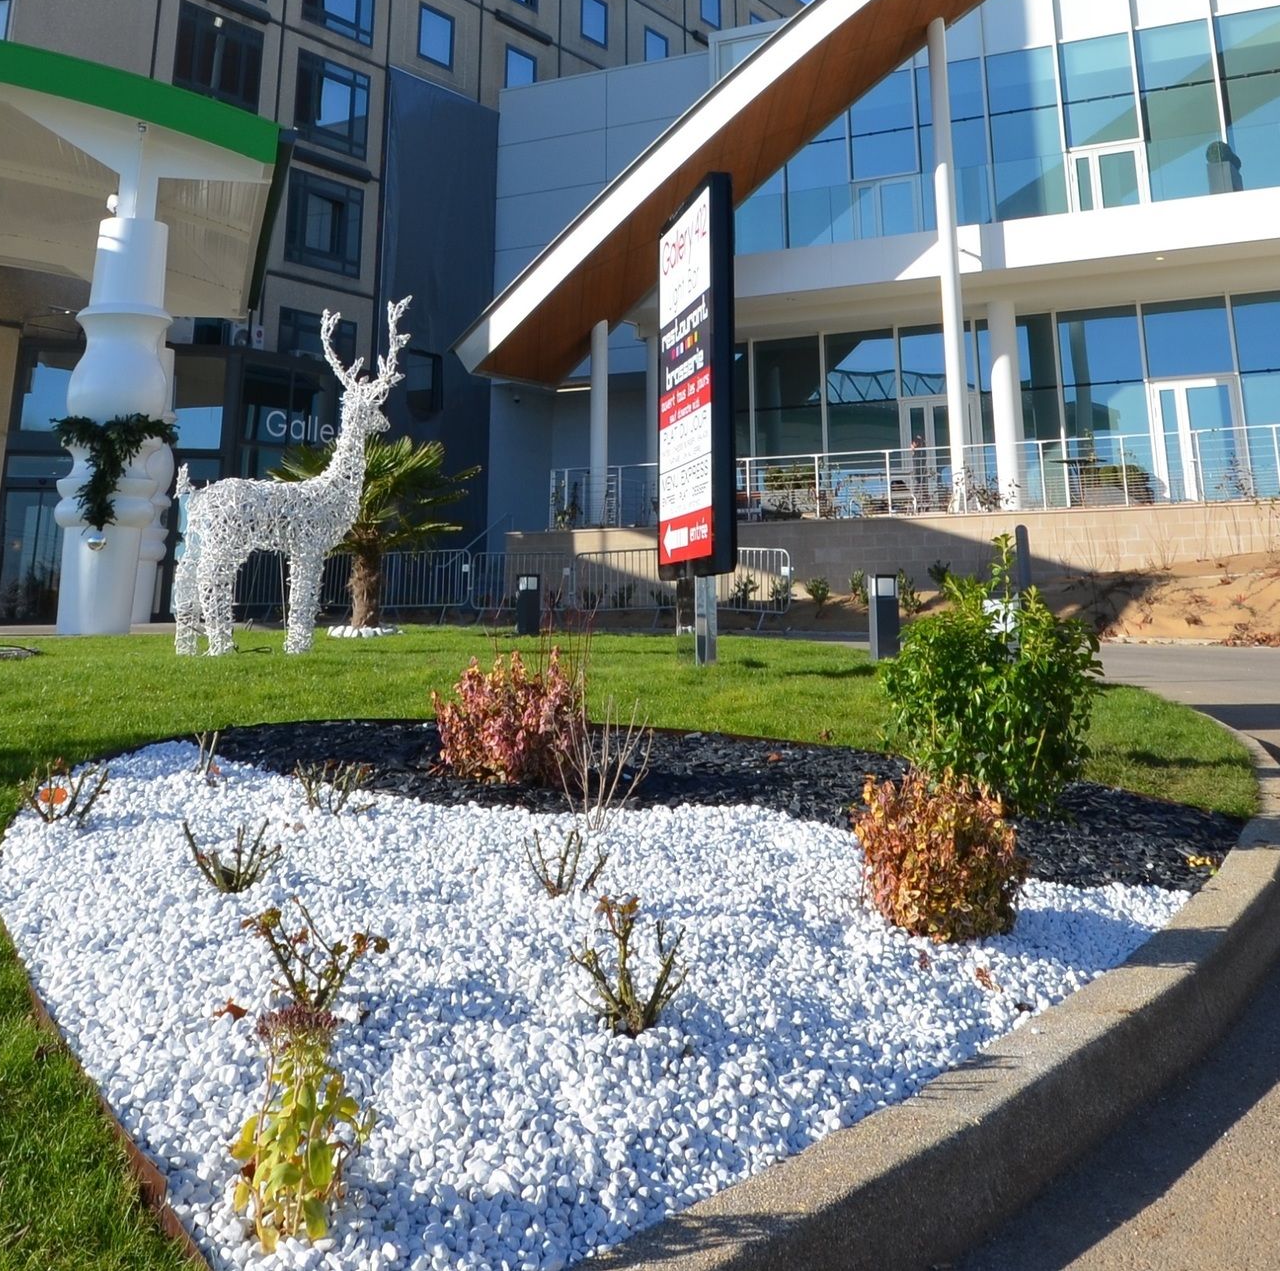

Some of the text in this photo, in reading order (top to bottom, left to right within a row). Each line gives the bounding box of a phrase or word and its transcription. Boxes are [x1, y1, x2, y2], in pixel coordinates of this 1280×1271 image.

[661, 294, 709, 354] restaurant
[665, 347, 704, 392] brasserie
[689, 516, 709, 543] entrée
